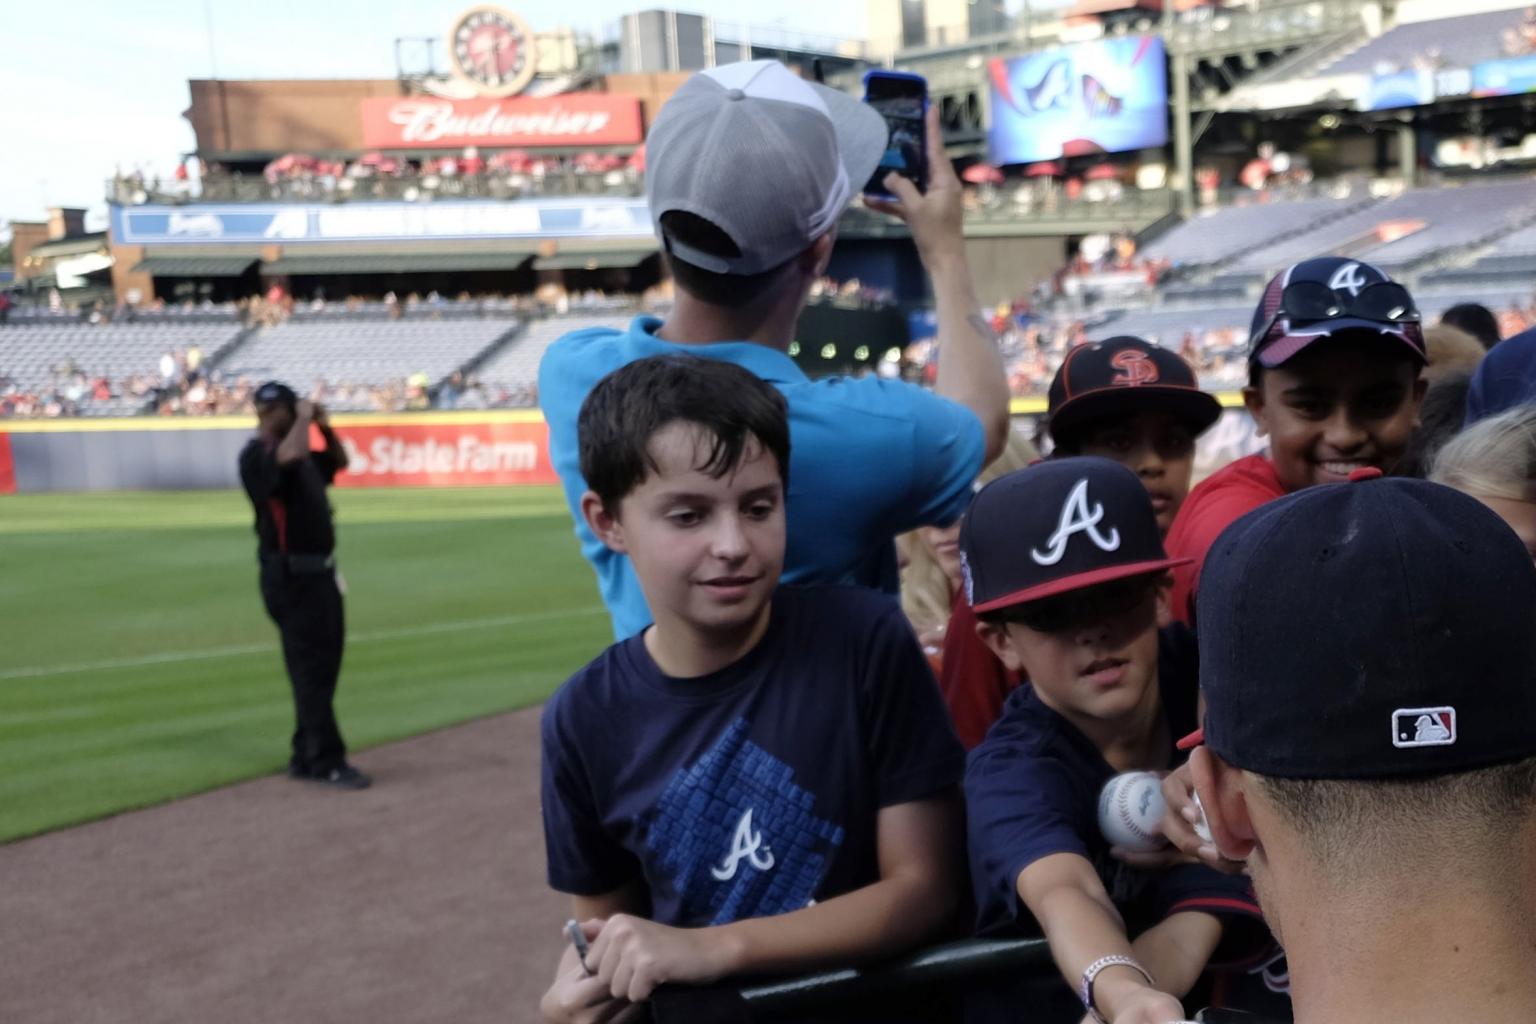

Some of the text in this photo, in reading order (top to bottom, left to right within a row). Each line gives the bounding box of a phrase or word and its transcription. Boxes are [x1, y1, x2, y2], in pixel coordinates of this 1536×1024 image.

[388, 102, 610, 142] Budweiser
[1031, 478, 1121, 567] A
[711, 807, 776, 881] A
